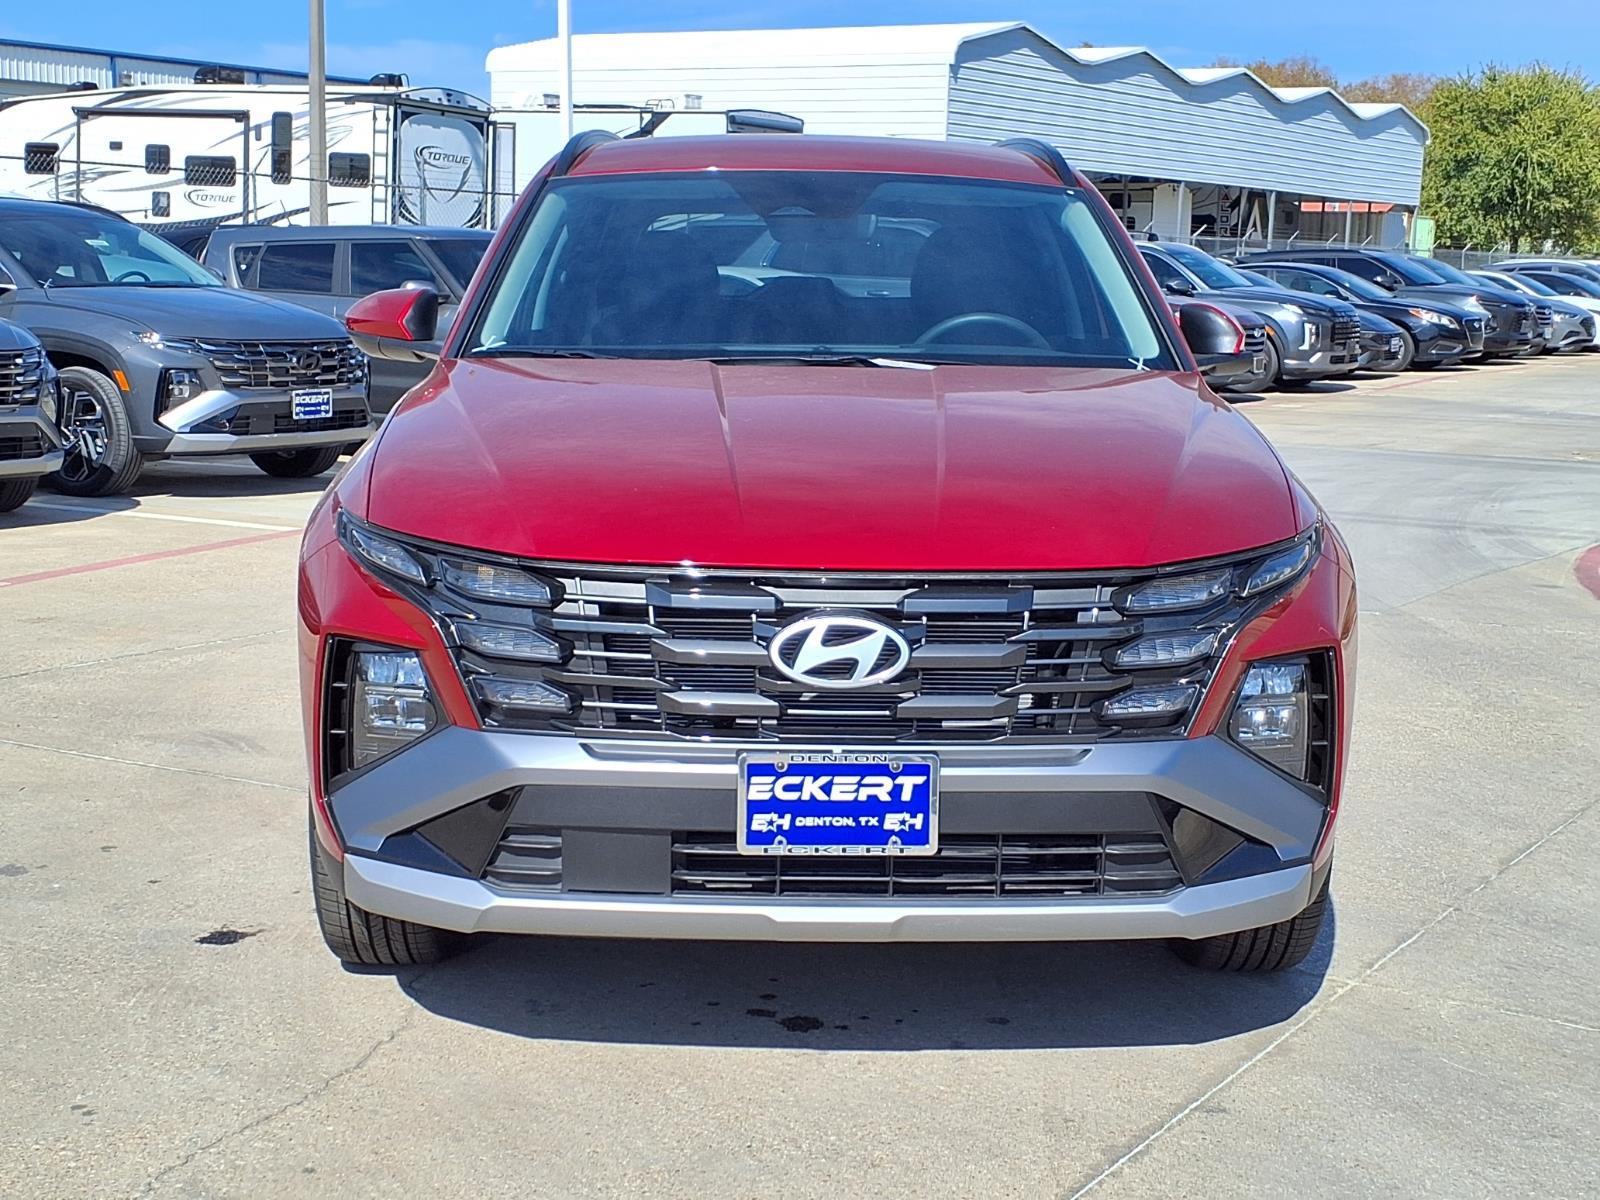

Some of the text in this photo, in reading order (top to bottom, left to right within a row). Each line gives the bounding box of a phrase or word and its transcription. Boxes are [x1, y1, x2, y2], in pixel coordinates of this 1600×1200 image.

[427, 151, 472, 165] TORQUE
[295, 394, 330, 403] ECKERT
[790, 754, 889, 763] DENTON
[747, 775, 928, 802] ECKERT
[795, 816, 856, 828] DENTON,
[858, 816, 880, 827] TX
[762, 846, 913, 854] ECKERT
